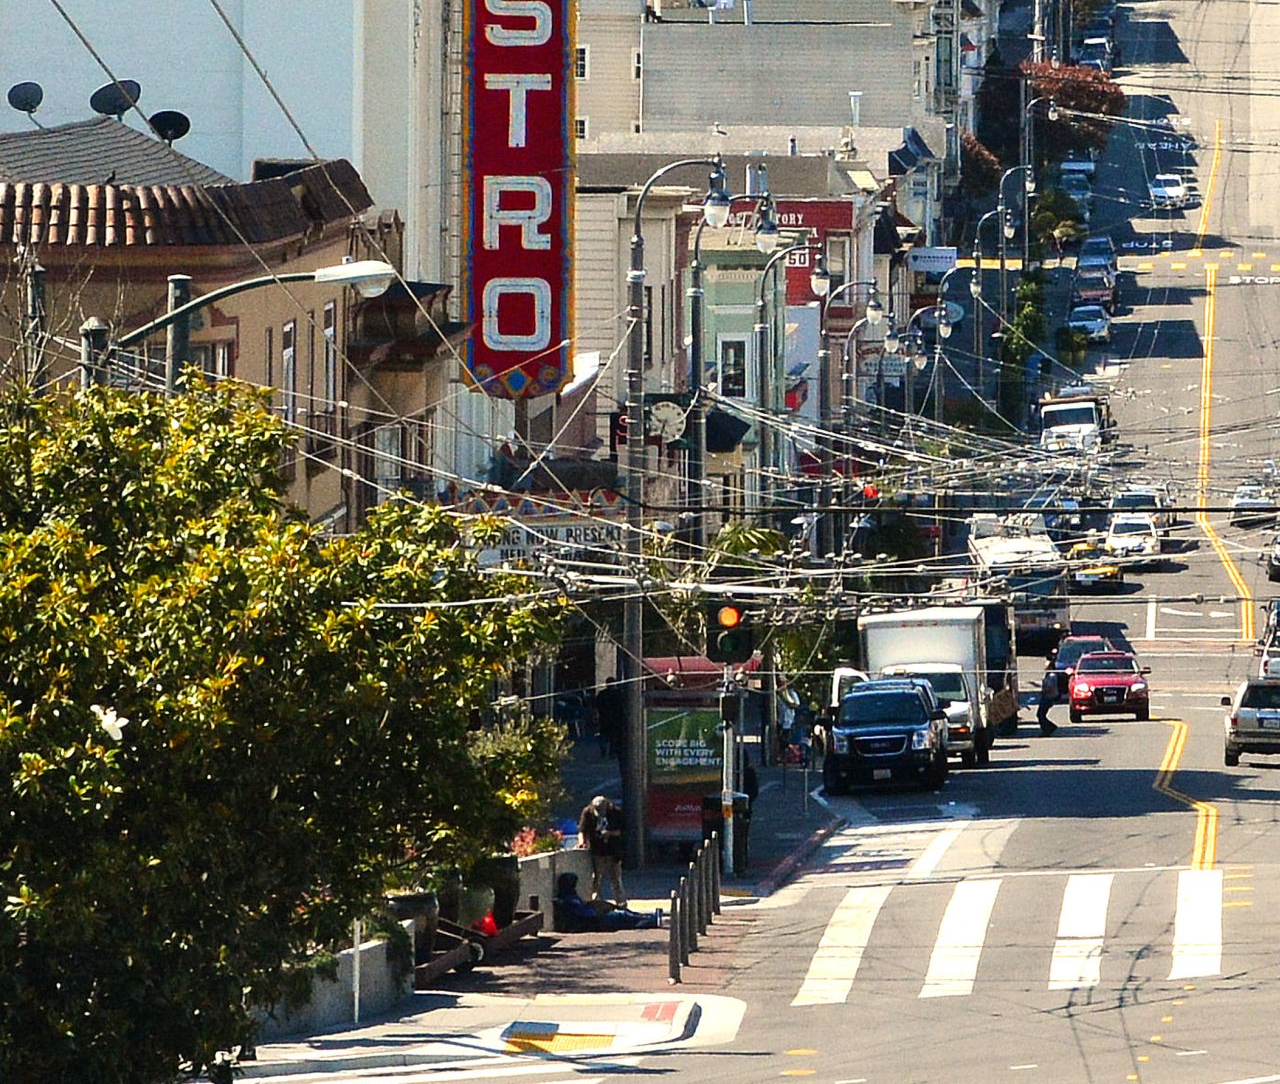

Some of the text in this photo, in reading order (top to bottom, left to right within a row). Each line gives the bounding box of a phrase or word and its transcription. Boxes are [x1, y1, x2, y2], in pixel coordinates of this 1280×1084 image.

[1122, 240, 1174, 248] STOP
[526, 527, 559, 545] NOW
[655, 739, 706, 748] SCORE BIG
[655, 748, 715, 757] WITH EVERY
